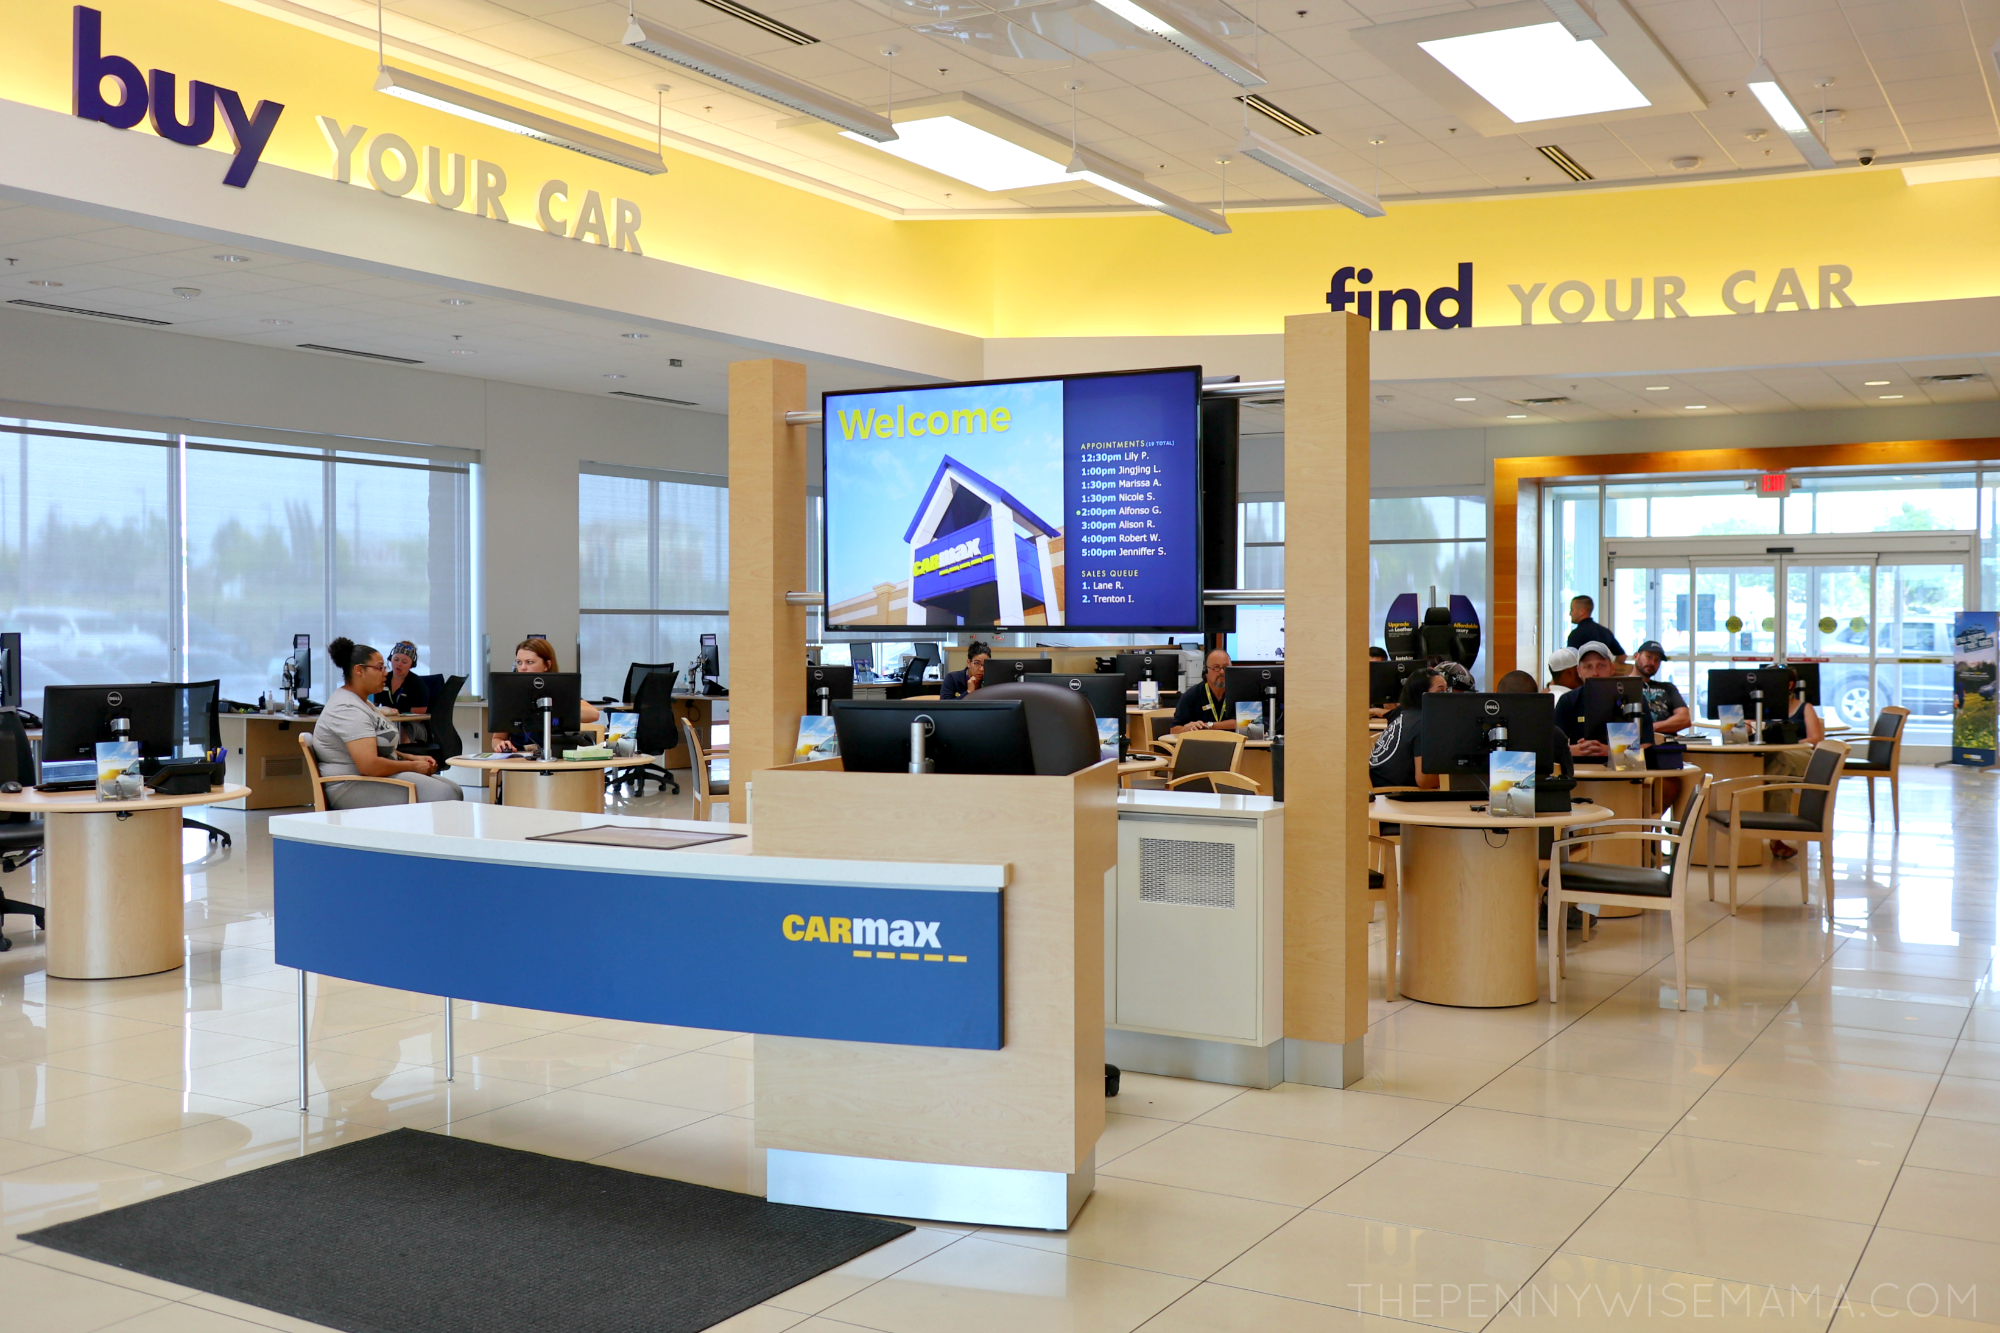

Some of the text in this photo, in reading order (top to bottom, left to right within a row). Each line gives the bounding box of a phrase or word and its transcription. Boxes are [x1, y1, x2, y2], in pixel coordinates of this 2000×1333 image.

[73, 5, 643, 255] buy YOUR CAR
[1326, 262, 1857, 331] find YOUR CAR
[837, 404, 1011, 440] Welcome
[1080, 440, 1145, 450] APPOINTMENTS
[1081, 451, 1150, 463] 12:30pm Lily P.
[1081, 465, 1161, 476] 1:00pm Jingjing L.
[1081, 478, 1162, 490] 1:30pm Marissa A.
[1762, 474, 1786, 492] EXIT
[1081, 492, 1156, 504] 1:30pm Nicole S.
[1081, 506, 1162, 517] 2:00pm Alfonso G.
[1081, 519, 1156, 531] 3:00pm Alison R.
[1081, 533, 1161, 544] 4:00pm Robert W.
[1081, 547, 1166, 558] 5:00pm Jenniffer S.
[1109, 569, 1139, 577] QUEUE
[1082, 581, 1124, 590] 1. Lane R.
[1082, 594, 1134, 603] 2. Trenton I.
[782, 913, 942, 948] CARmax
